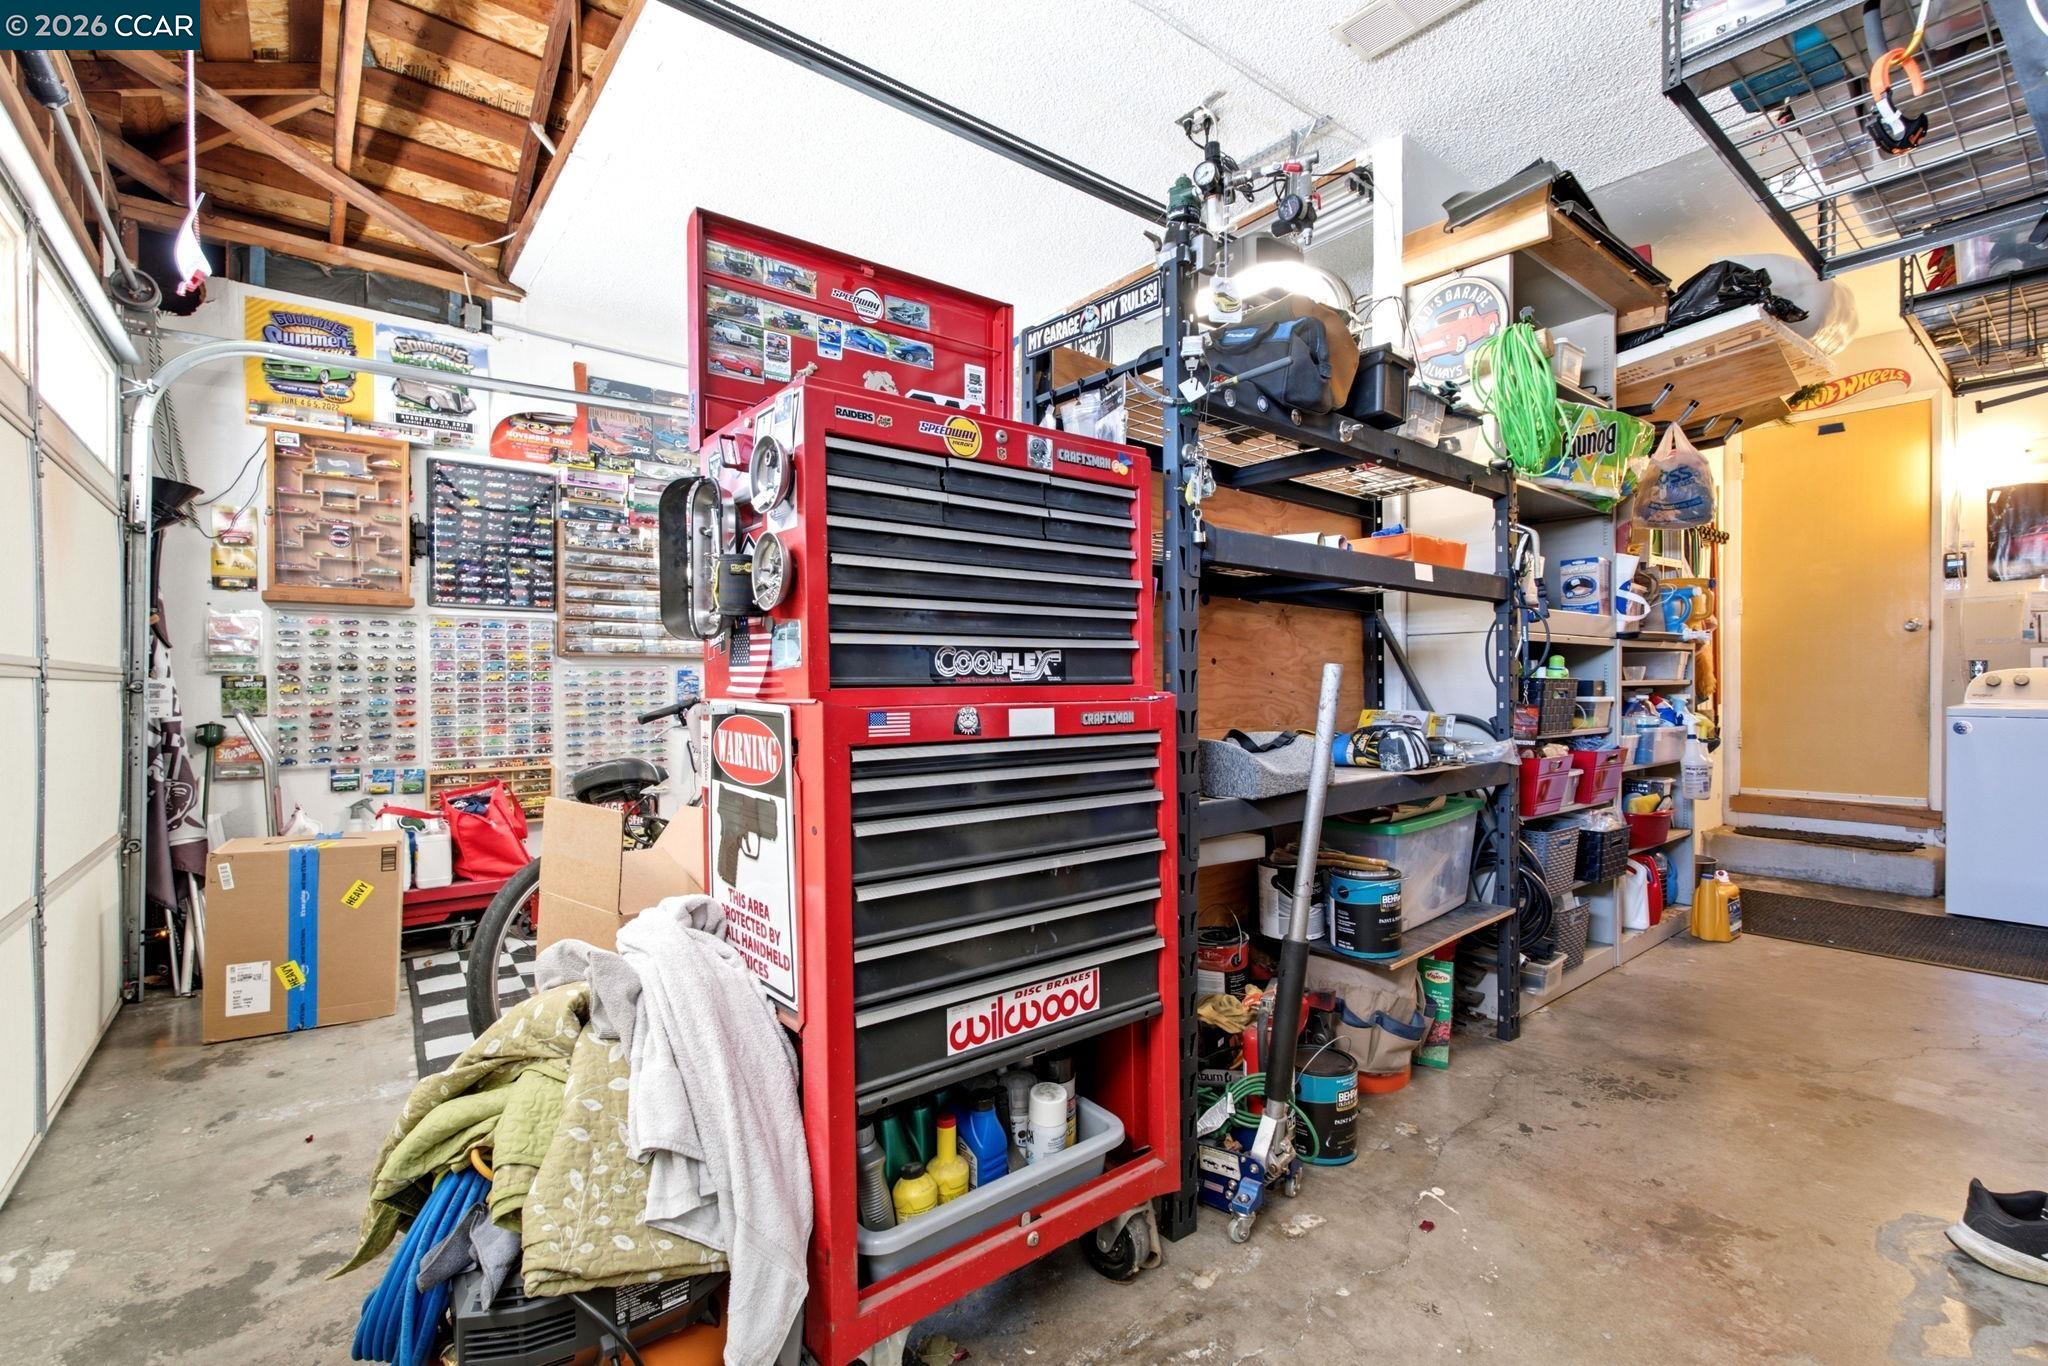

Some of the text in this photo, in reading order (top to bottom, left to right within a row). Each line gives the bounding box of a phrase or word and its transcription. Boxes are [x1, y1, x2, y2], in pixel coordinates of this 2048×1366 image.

[832, 290, 880, 312] SPEEDWAY
[1445, 285, 1493, 308] GARAGE
[1028, 332, 1043, 352] MY
[1044, 315, 1081, 344] GARAGE
[1101, 301, 1118, 325] MY
[1120, 281, 1158, 315] RULES!
[395, 338, 470, 364] GOODGUYS
[1421, 361, 1463, 378] ALWAYS
[322, 402, 340, 412] 2022
[835, 407, 874, 422] RAIDERS
[506, 430, 550, 442] NOVEMBER
[920, 422, 977, 442] SPEEDWAY
[1562, 422, 1617, 462] Bounty
[632, 445, 651, 455] 2022
[1057, 449, 1111, 470] CRAFTSMAN
[1081, 711, 1134, 727] CRAFTSMAN
[717, 728, 779, 775] WARNING
[346, 882, 369, 906] HEAVY
[728, 887, 771, 922] THIS AREA
[1382, 894, 1401, 904] BEHR
[769, 927, 781, 947] BY
[741, 932, 791, 972] HANDHELD
[281, 964, 300, 987] HEAVY
[1014, 971, 1092, 1000] DISC BRAKES
[949, 969, 1099, 1051] wilwood
[1339, 1089, 1358, 1103] BEHR
